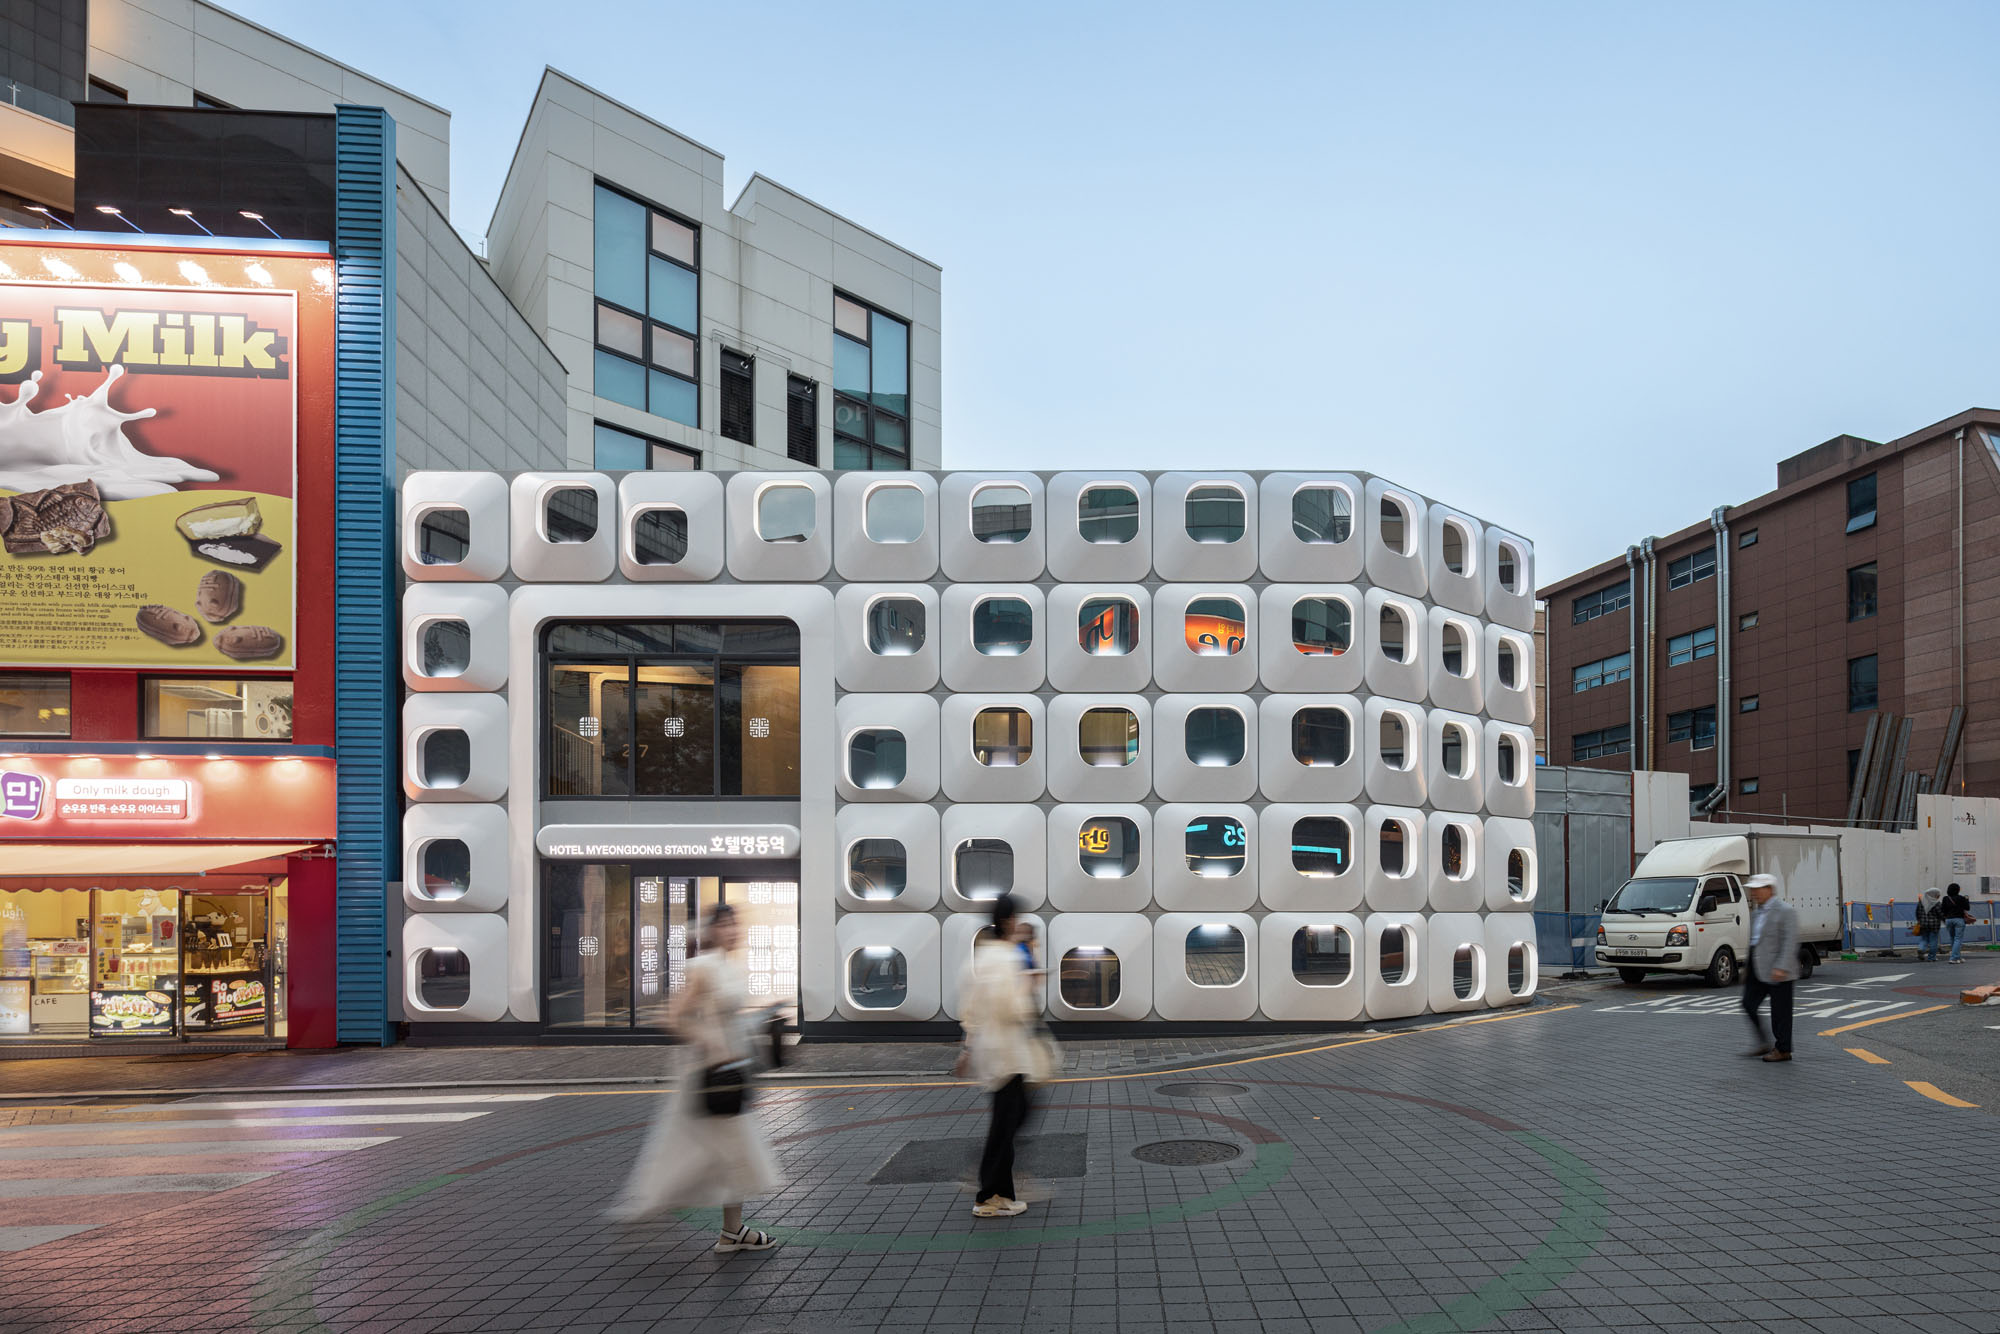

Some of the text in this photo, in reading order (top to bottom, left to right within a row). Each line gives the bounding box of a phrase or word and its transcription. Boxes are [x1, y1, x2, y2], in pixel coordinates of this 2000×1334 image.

[55, 307, 281, 374] Milk
[28, 581, 62, 589] 건강하고
[65, 582, 89, 590] 신선한
[58, 591, 91, 599] 부드러운
[6, 780, 40, 811] 만
[73, 785, 170, 797] Only milk dough
[61, 804, 88, 814] 순우유
[139, 804, 181, 814] 아이스크림
[549, 845, 707, 855] HOTEL MYEONGDONG STATION
[709, 835, 785, 855] 호텔명동역
[212, 980, 228, 993] So
[34, 998, 57, 1006] CAFE
